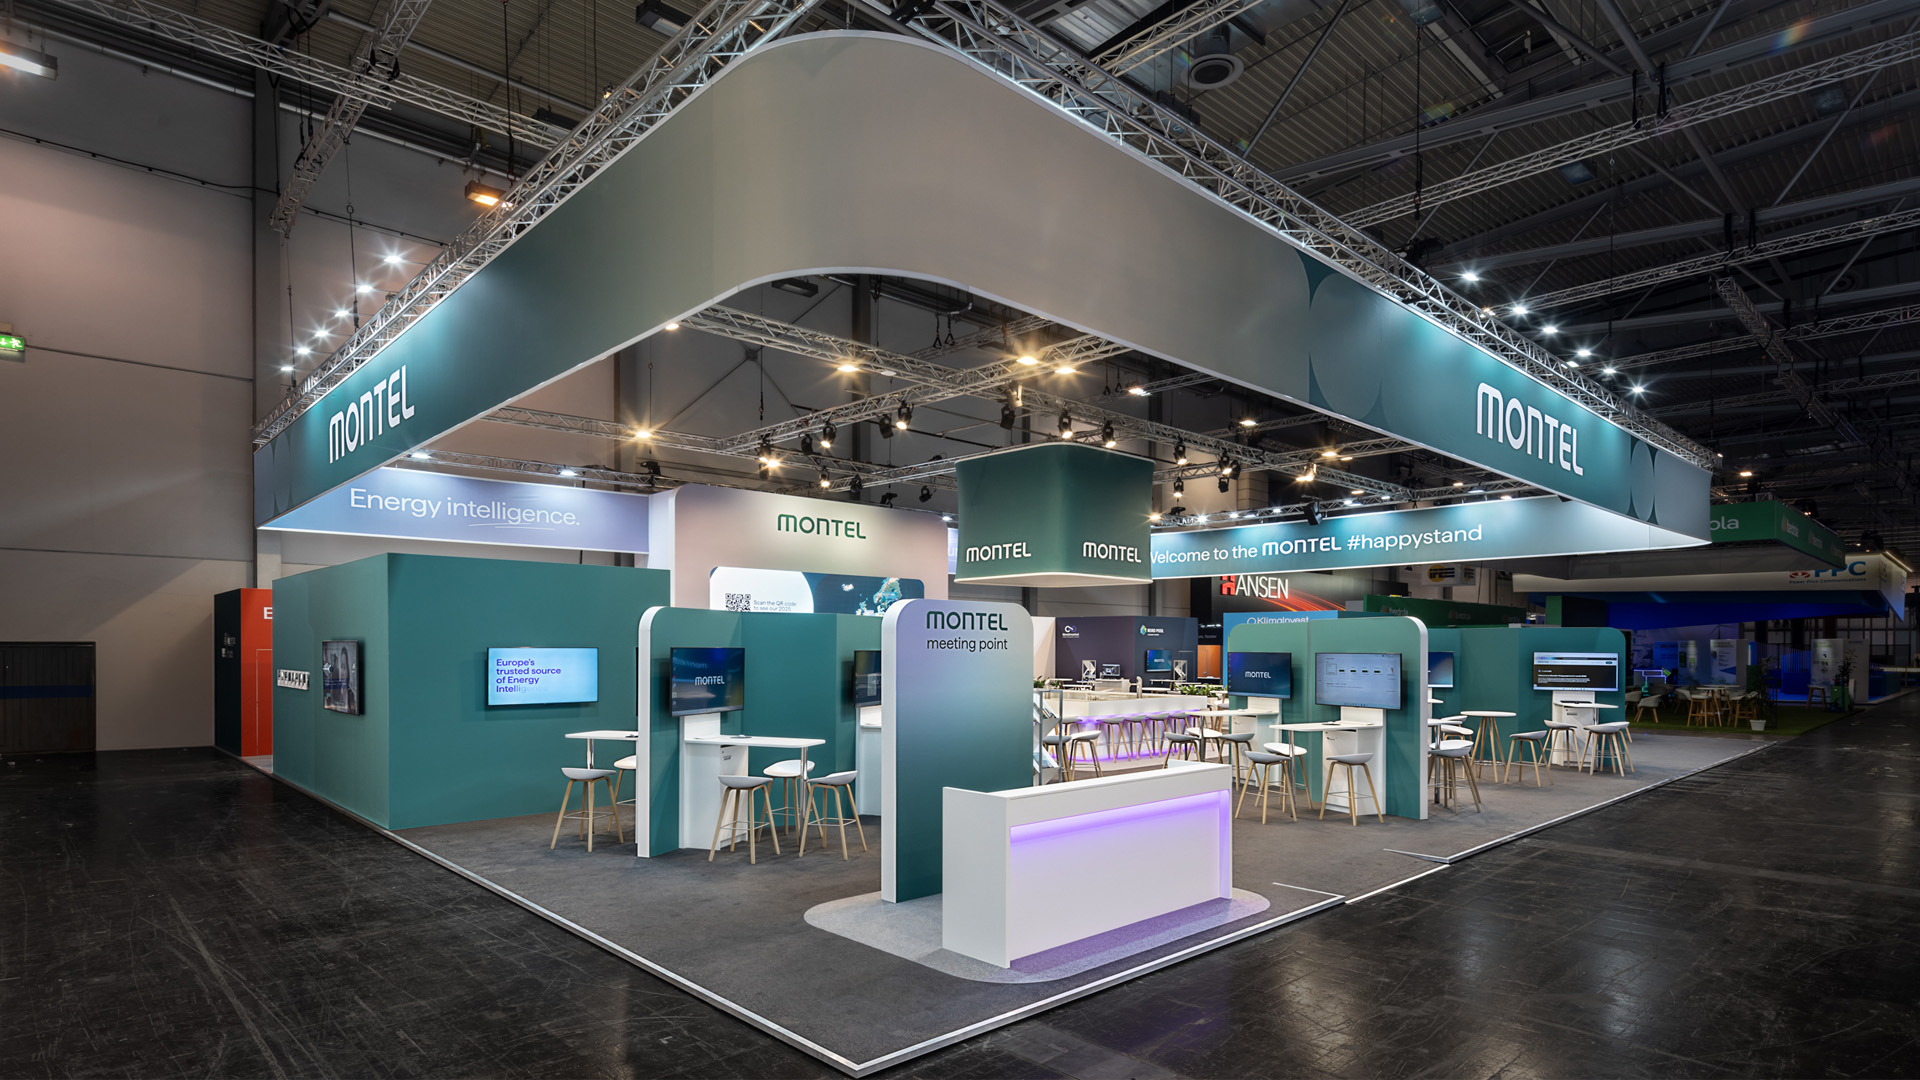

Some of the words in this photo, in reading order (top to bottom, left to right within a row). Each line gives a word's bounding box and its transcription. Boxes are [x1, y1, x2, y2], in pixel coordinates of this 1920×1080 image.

[329, 364, 415, 464] MONTEL
[1476, 382, 1584, 476] MONTEL
[350, 487, 441, 518] Energy
[447, 496, 580, 525] intelligence.
[777, 513, 867, 539] MONTEL
[966, 541, 1032, 563] MONTEL
[1082, 541, 1142, 563] MONTEL
[1213, 547, 1229, 560] to
[1232, 544, 1258, 559] the
[1262, 537, 1342, 556] MONTEL
[1347, 525, 1483, 552] #happystand
[1221, 574, 1289, 599] HANSEN
[926, 610, 1008, 631] MONTEL
[927, 636, 976, 652] meeting
[979, 637, 1008, 652] point
[496, 658, 535, 667] Europe's
[496, 667, 529, 675] trusted
[496, 676, 506, 684] of
[507, 676, 540, 685] Energy
[694, 675, 725, 686] MONTEL
[1244, 671, 1271, 679] MONTEL
